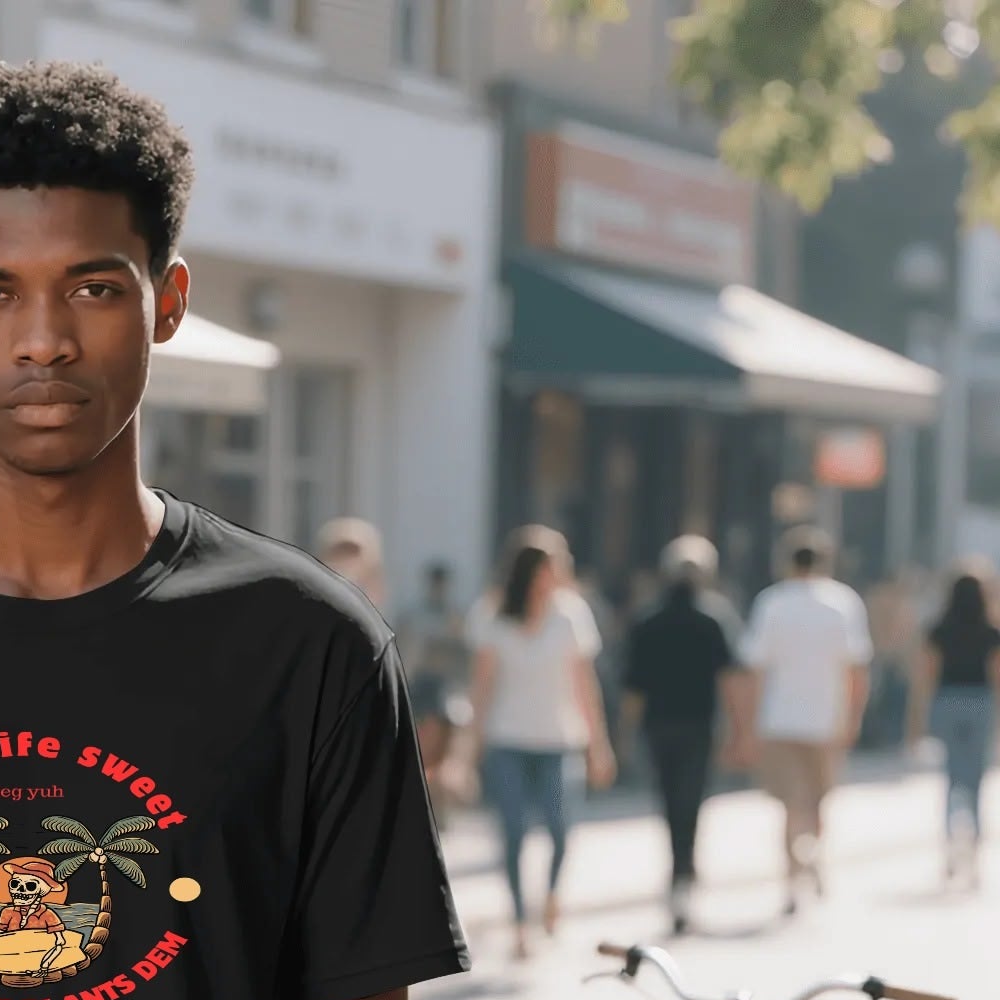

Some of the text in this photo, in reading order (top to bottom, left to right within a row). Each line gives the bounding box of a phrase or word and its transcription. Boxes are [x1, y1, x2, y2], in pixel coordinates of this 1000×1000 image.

[27, 784, 64, 801] yuh
[76, 746, 188, 830] sweet
[131, 930, 189, 982] DEM
